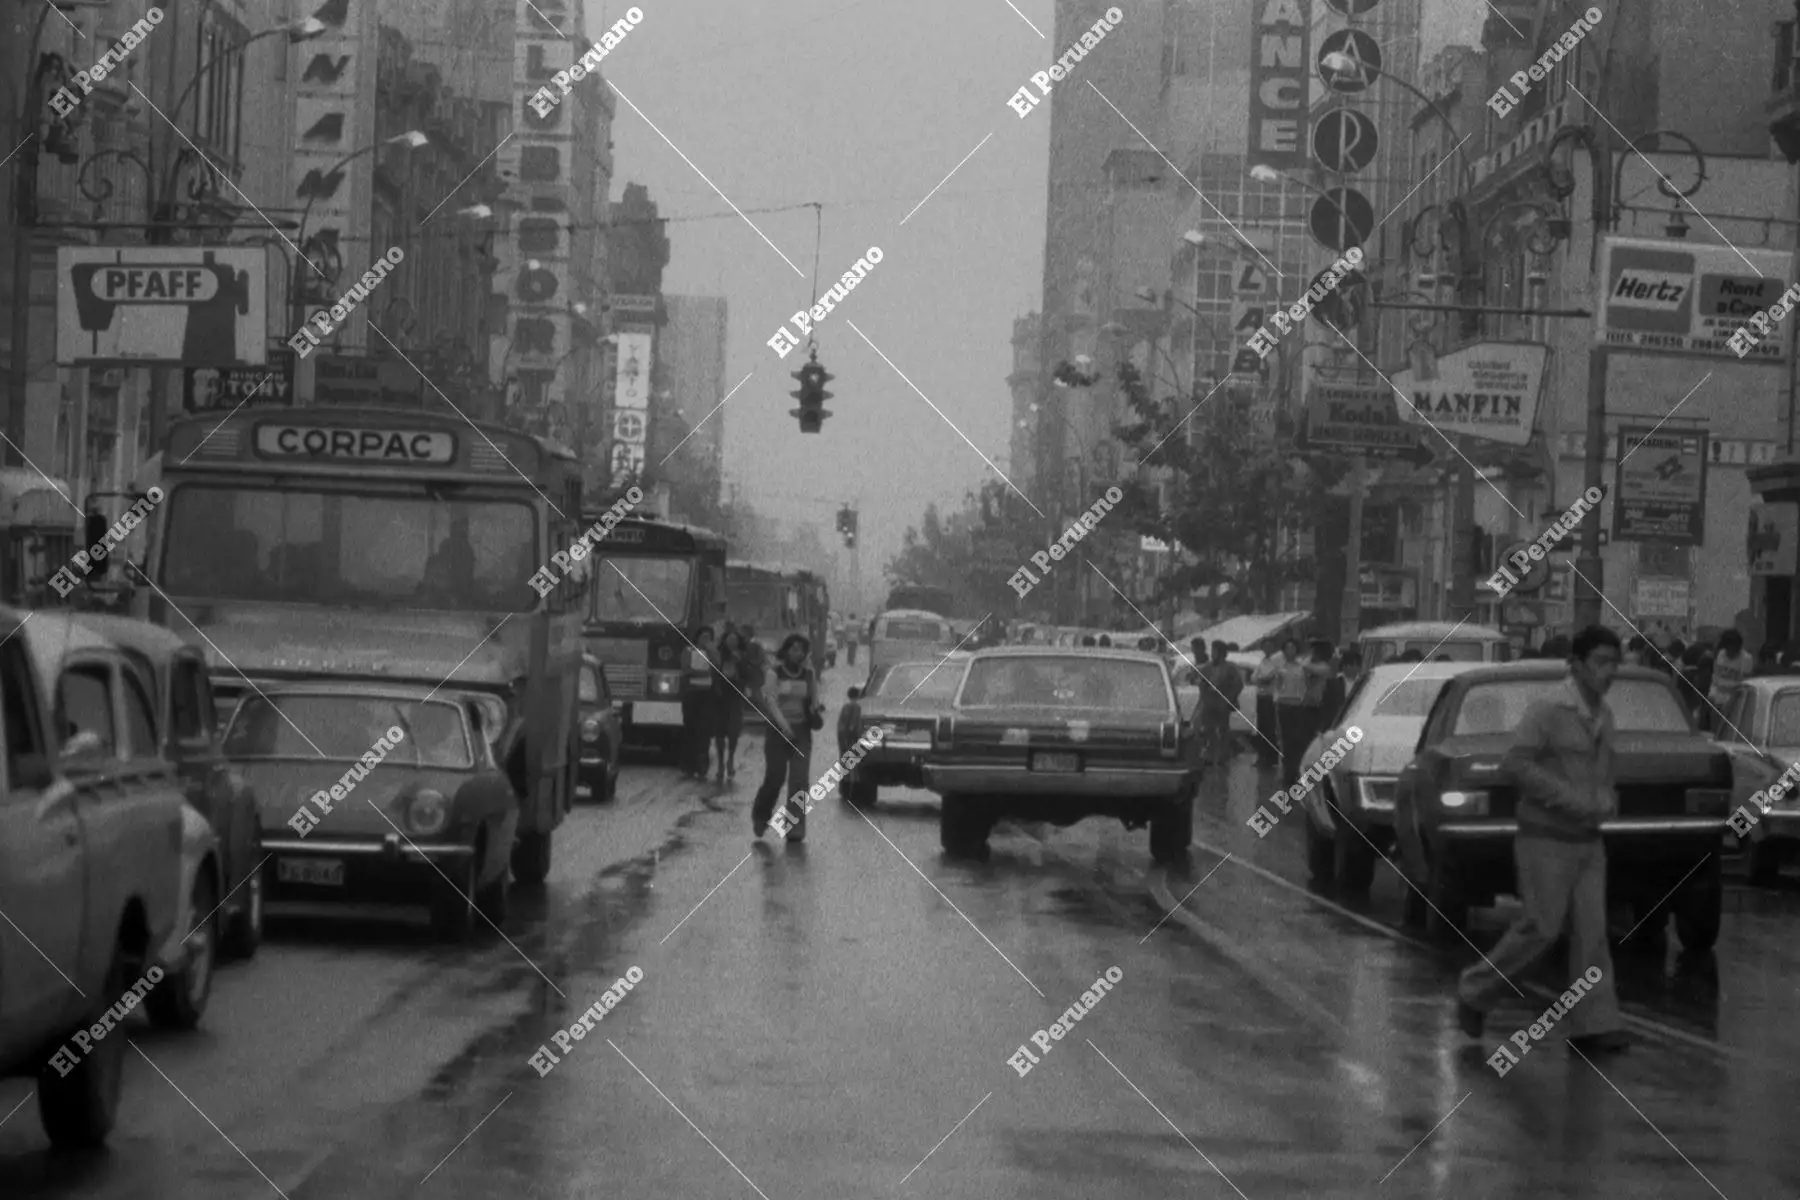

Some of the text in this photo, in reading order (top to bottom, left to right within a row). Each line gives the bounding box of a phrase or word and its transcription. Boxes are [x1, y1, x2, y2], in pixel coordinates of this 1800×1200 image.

[106, 270, 202, 298] PFAFF
[1616, 278, 1684, 301] Hertz
[1721, 279, 1764, 297] Rent
[227, 381, 289, 398] TONY
[277, 427, 432, 459] CORPAC
